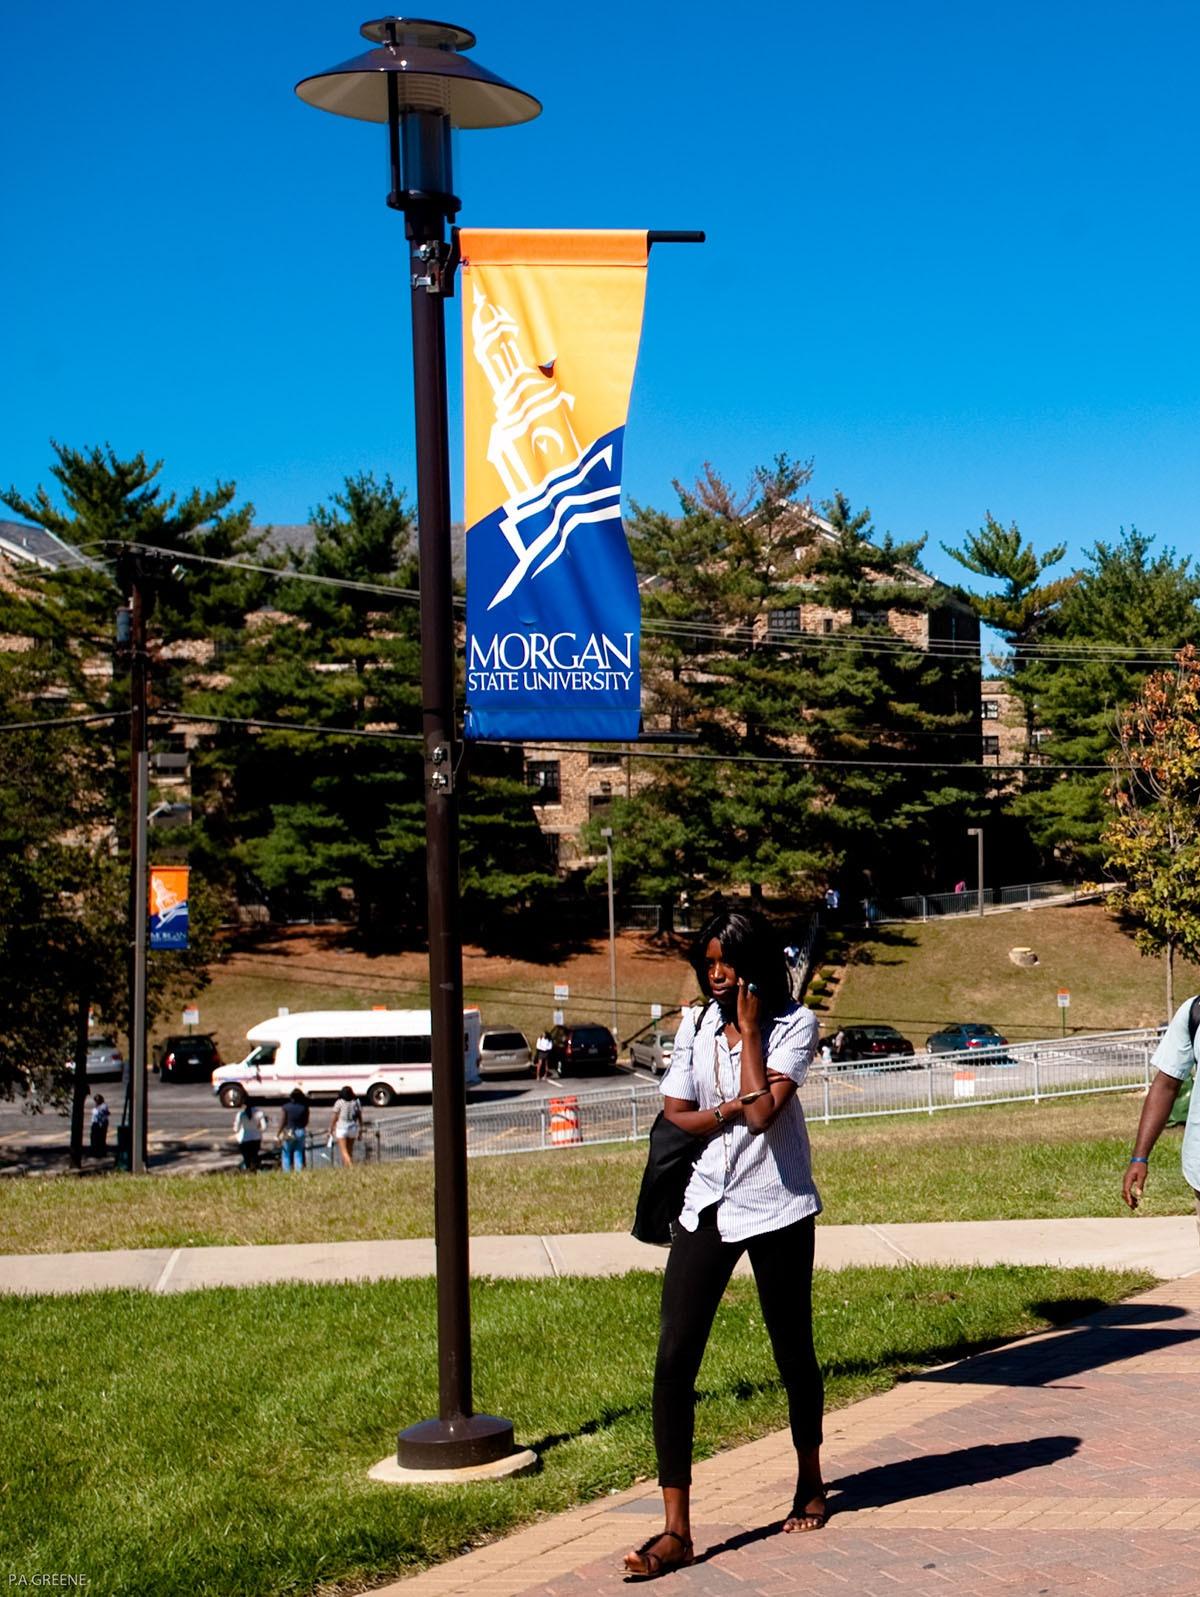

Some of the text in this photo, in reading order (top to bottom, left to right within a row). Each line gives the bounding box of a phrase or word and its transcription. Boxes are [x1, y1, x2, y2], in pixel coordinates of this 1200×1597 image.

[468, 632, 635, 671] MORGAN
[468, 671, 635, 691] STATE UNIVERSITY
